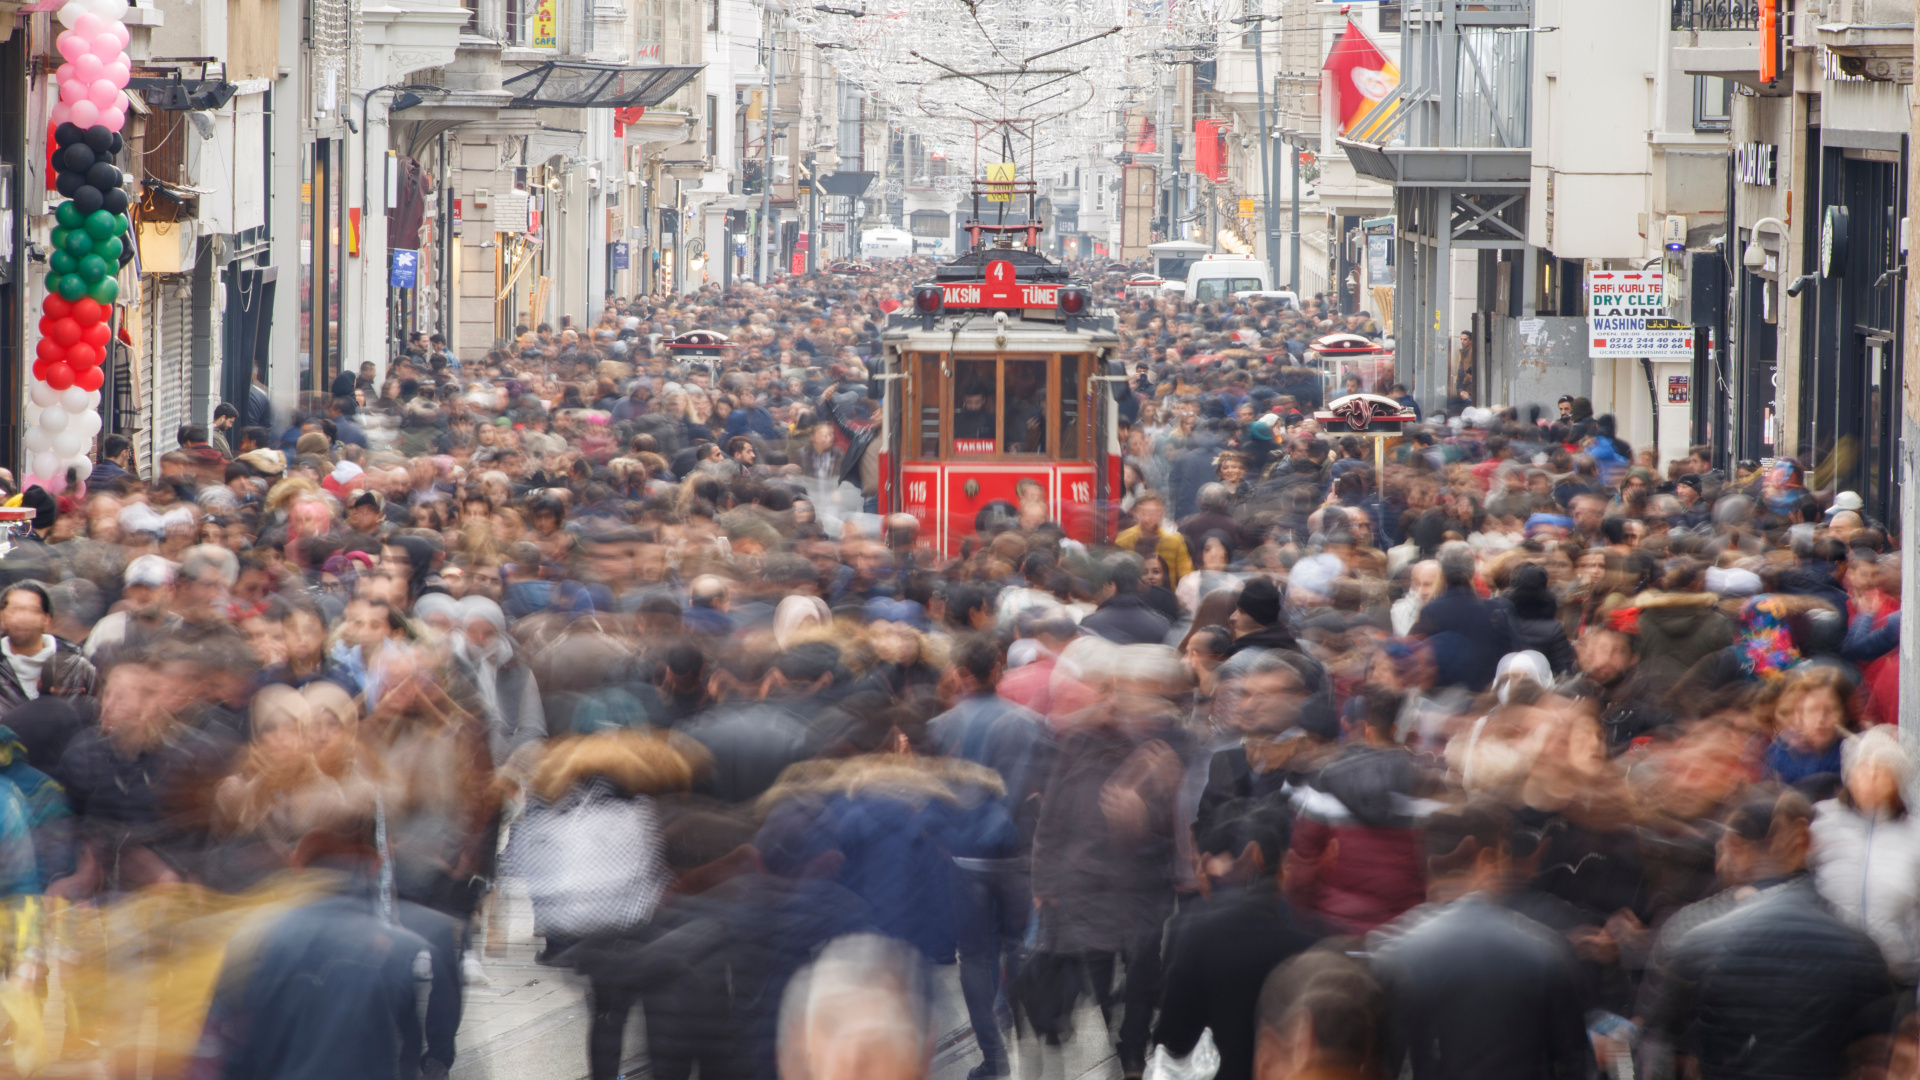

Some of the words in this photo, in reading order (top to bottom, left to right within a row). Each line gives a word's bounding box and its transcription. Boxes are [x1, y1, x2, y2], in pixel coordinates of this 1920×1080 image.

[535, 37, 556, 45] CAFE
[994, 262, 1004, 281] 4
[943, 285, 980, 303] AKSİM
[1618, 284, 1645, 293] KURU
[1593, 295, 1623, 306] DRY
[1593, 318, 1645, 330] WASHING
[956, 440, 994, 452] TAKSİM
